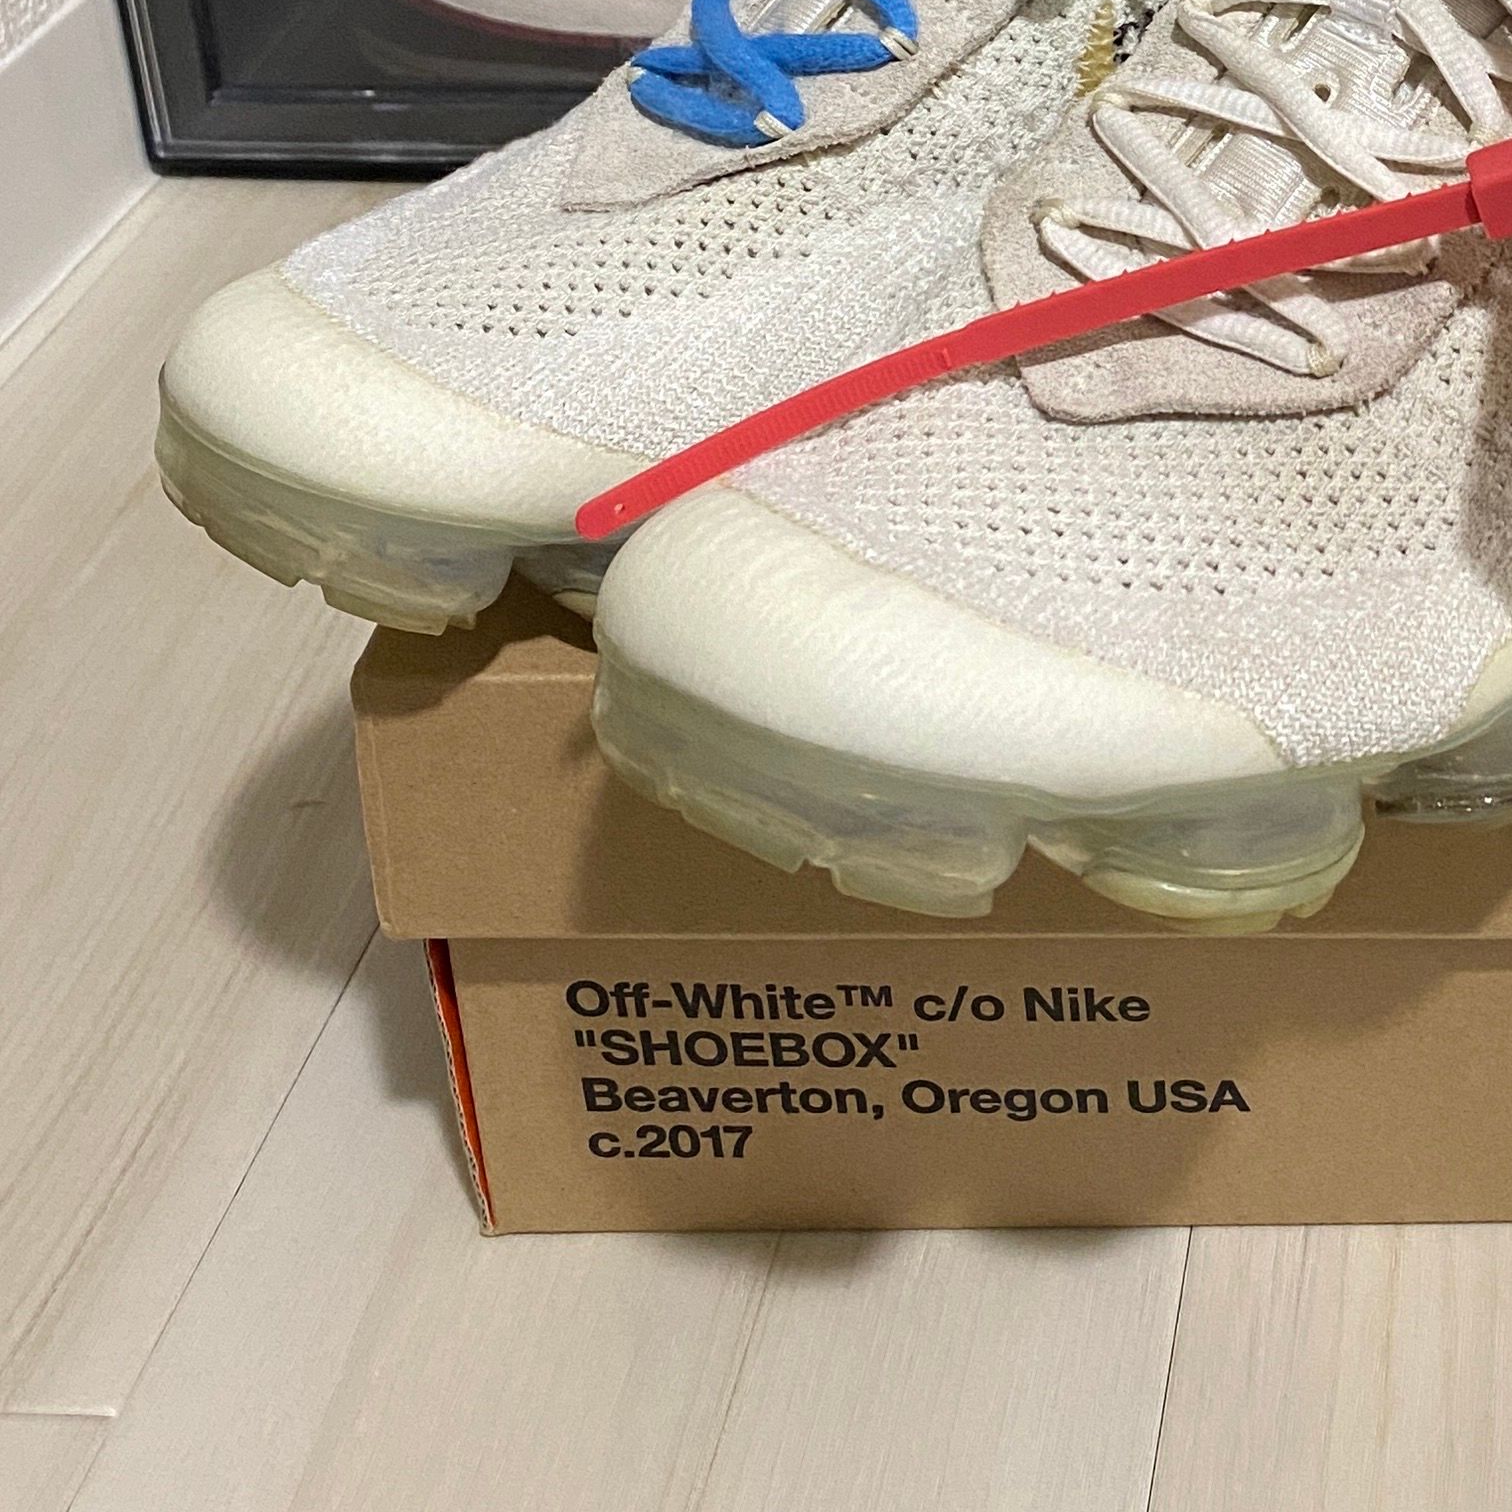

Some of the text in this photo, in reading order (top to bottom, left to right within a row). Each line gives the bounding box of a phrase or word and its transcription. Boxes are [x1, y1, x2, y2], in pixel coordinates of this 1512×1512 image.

[913, 985, 1005, 1022] c/o
[1022, 986, 1151, 1023] Nike
[573, 1029, 920, 1069] "SHOEBOX"
[581, 1076, 1251, 1122] Beaverton, Oregon USA
[588, 1124, 754, 1159] c.2017
